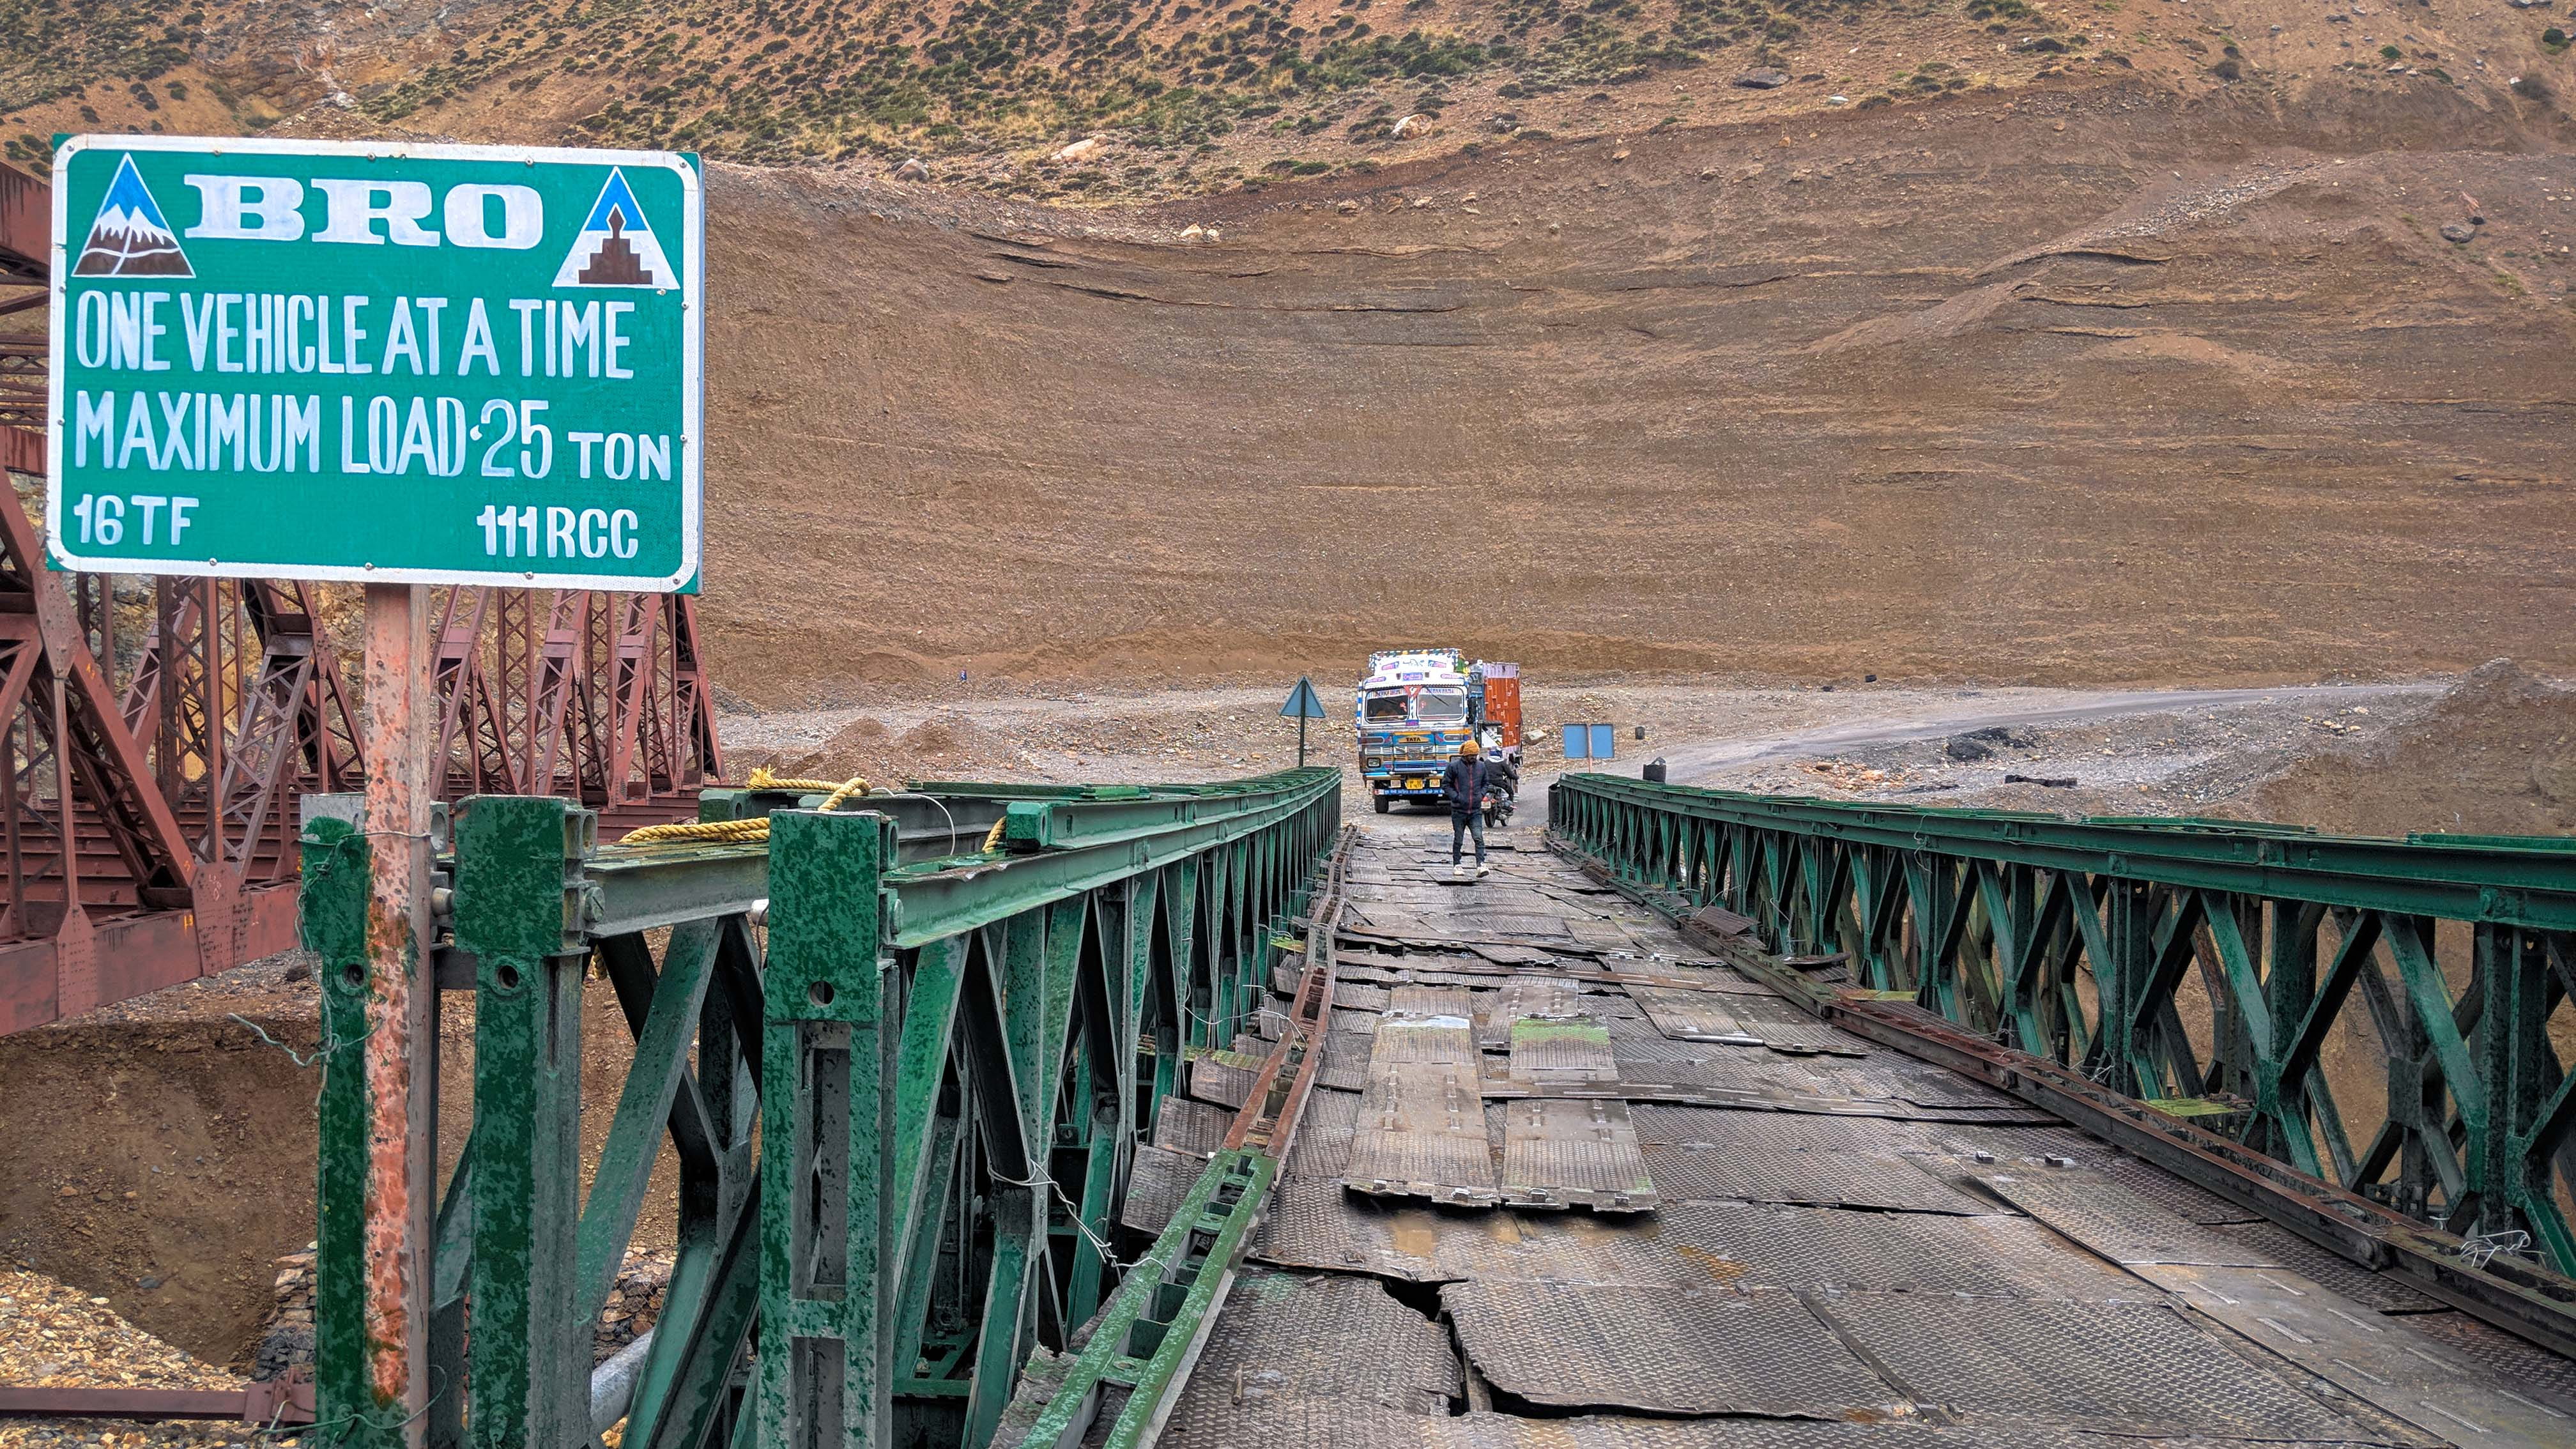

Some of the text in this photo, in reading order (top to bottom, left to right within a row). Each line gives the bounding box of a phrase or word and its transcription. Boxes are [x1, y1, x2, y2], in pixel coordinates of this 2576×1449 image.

[184, 174, 544, 250] BRO
[77, 290, 634, 379] ONE VEHICLE AT A TIME
[76, 390, 320, 473] MAXIMUM
[342, 395, 466, 477] LOAD
[568, 431, 671, 481] TON
